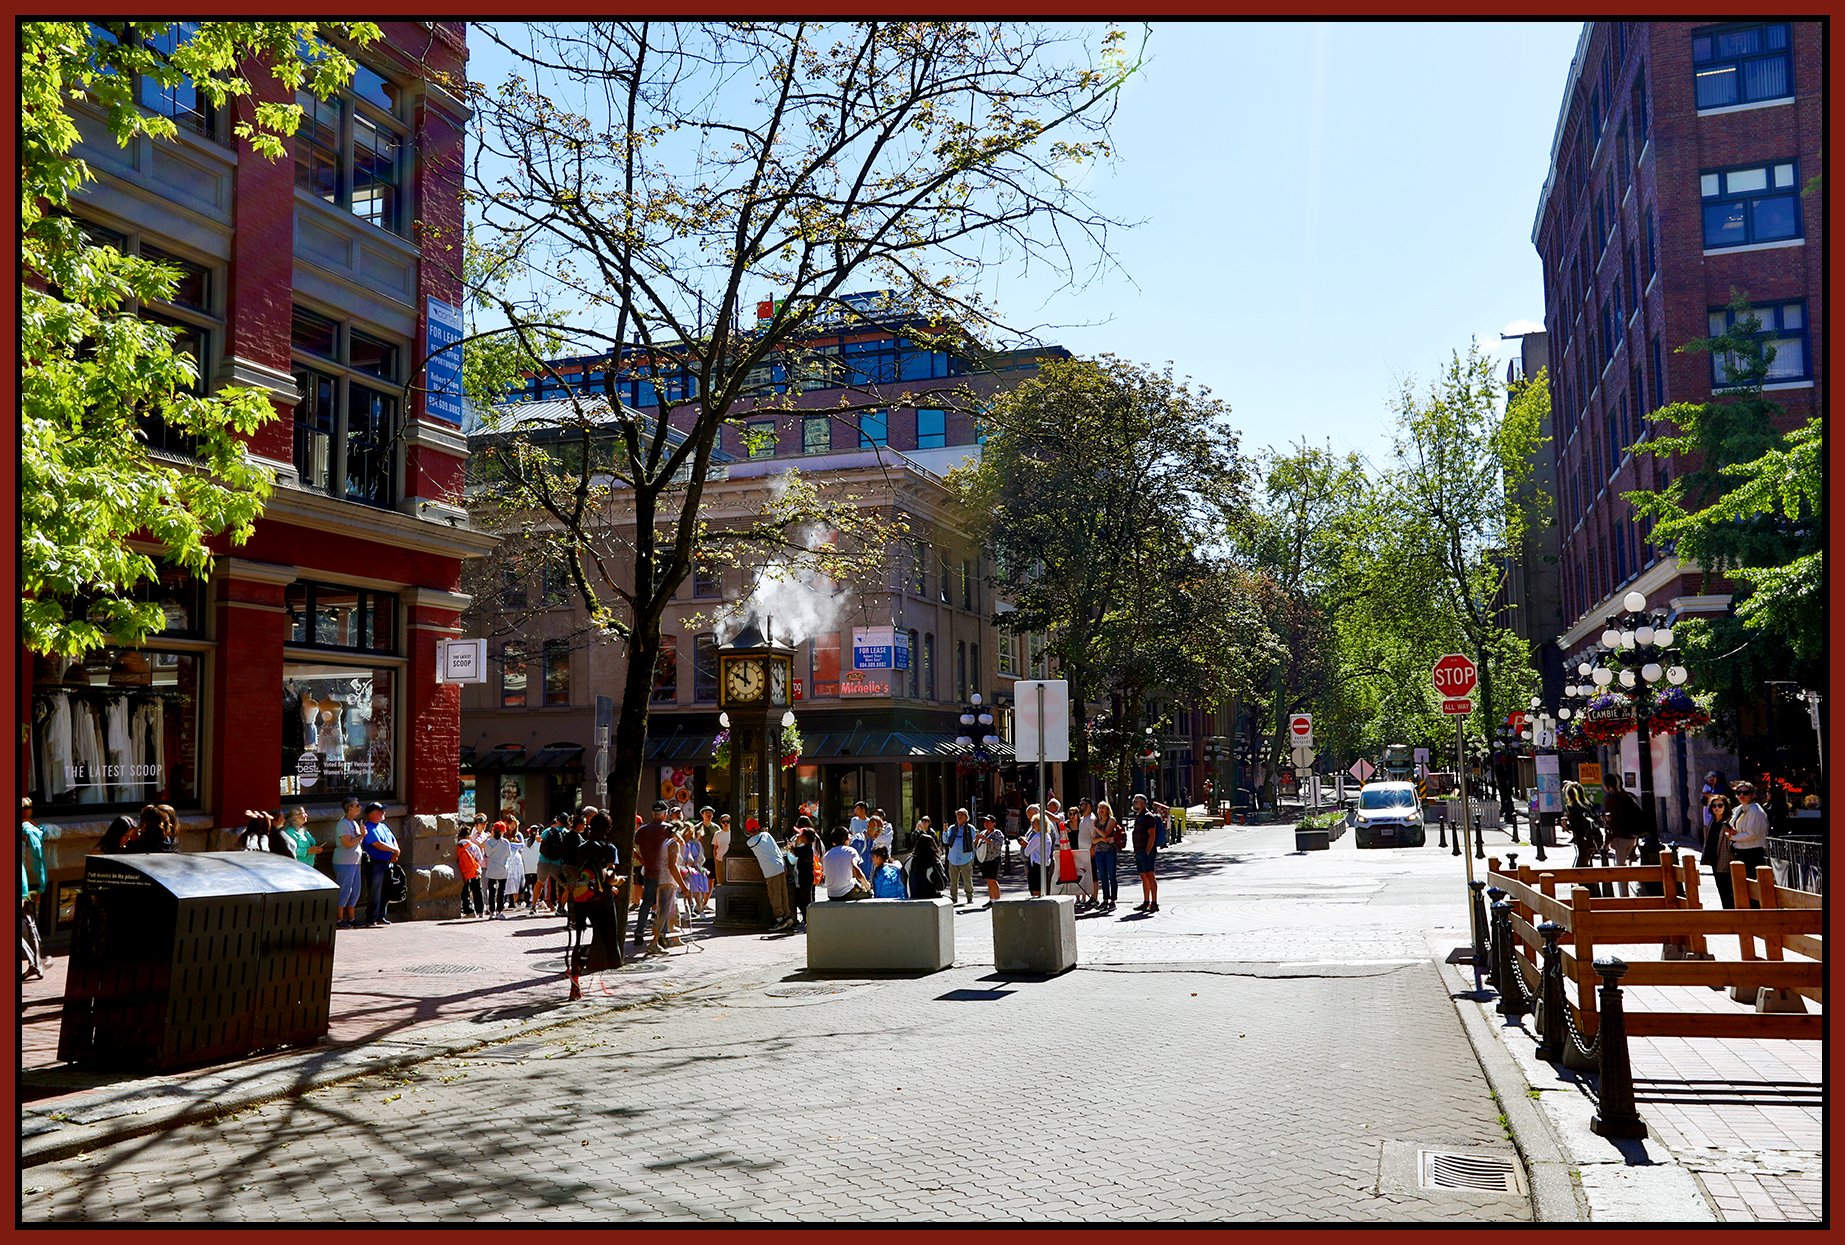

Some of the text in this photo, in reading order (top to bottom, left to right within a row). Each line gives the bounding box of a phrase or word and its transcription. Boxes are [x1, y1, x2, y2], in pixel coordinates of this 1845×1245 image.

[429, 324, 462, 348] FOR LEASE
[430, 371, 447, 385] Robert
[1435, 667, 1474, 686] STOP
[841, 681, 889, 694] Michelle's
[1592, 709, 1619, 719] CAMBIE
[64, 764, 163, 778] THE LATEST SCOOP
[295, 762, 321, 773] best
